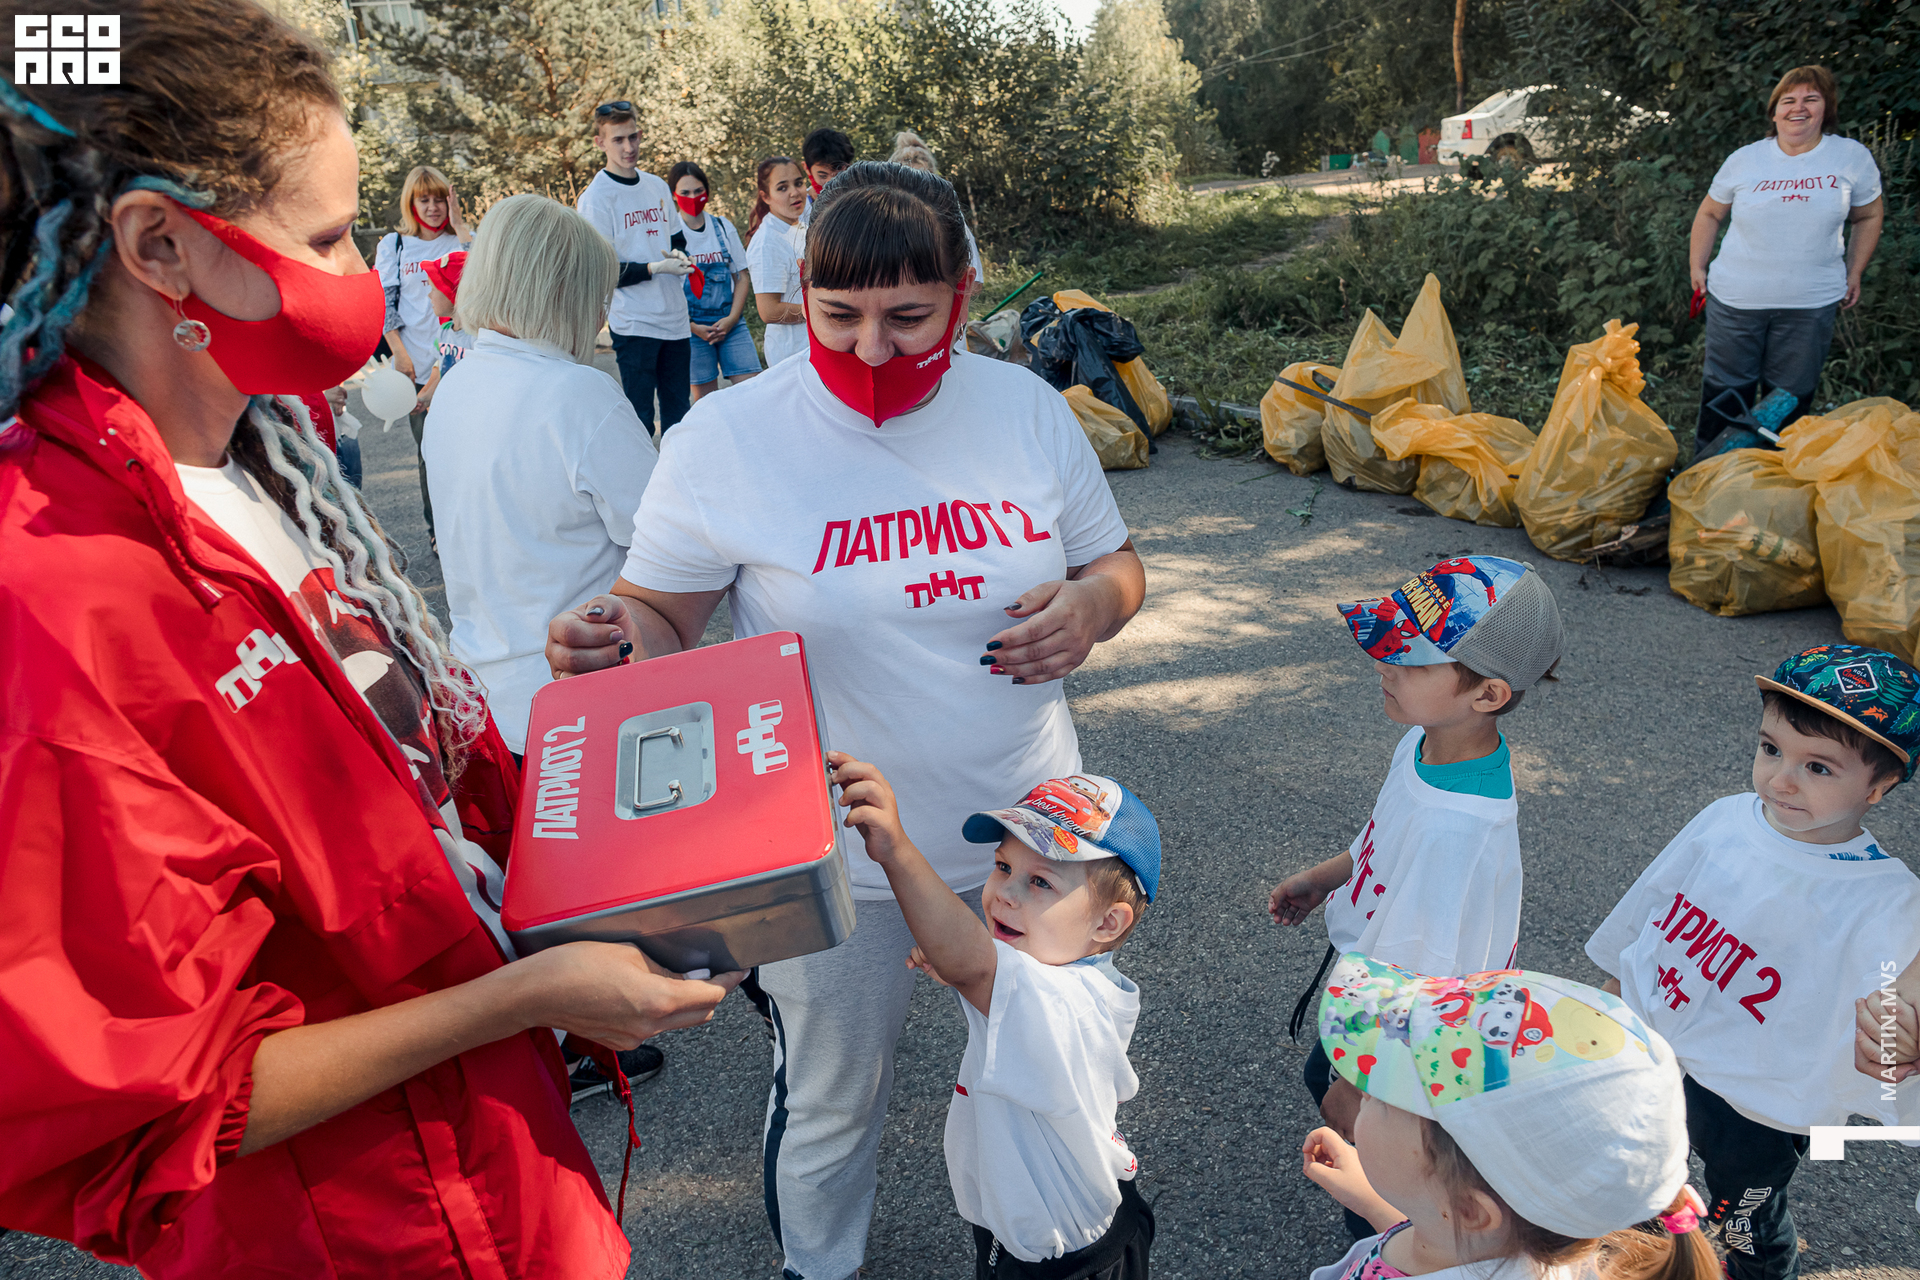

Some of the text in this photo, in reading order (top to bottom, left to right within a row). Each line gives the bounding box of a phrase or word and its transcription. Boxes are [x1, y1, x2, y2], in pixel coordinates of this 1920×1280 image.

[1752, 174, 1839, 193] ПАТРИОТ 2
[916, 348, 945, 369] ТНТ
[811, 499, 1052, 576] ПАТРИОТ 2
[904, 570, 988, 609] ТНТ
[736, 699, 789, 776] ТНТ
[532, 715, 587, 839] ПАТРИОТ 2
[1031, 796, 1092, 837] best friend
[1738, 966, 1782, 1025] 2
